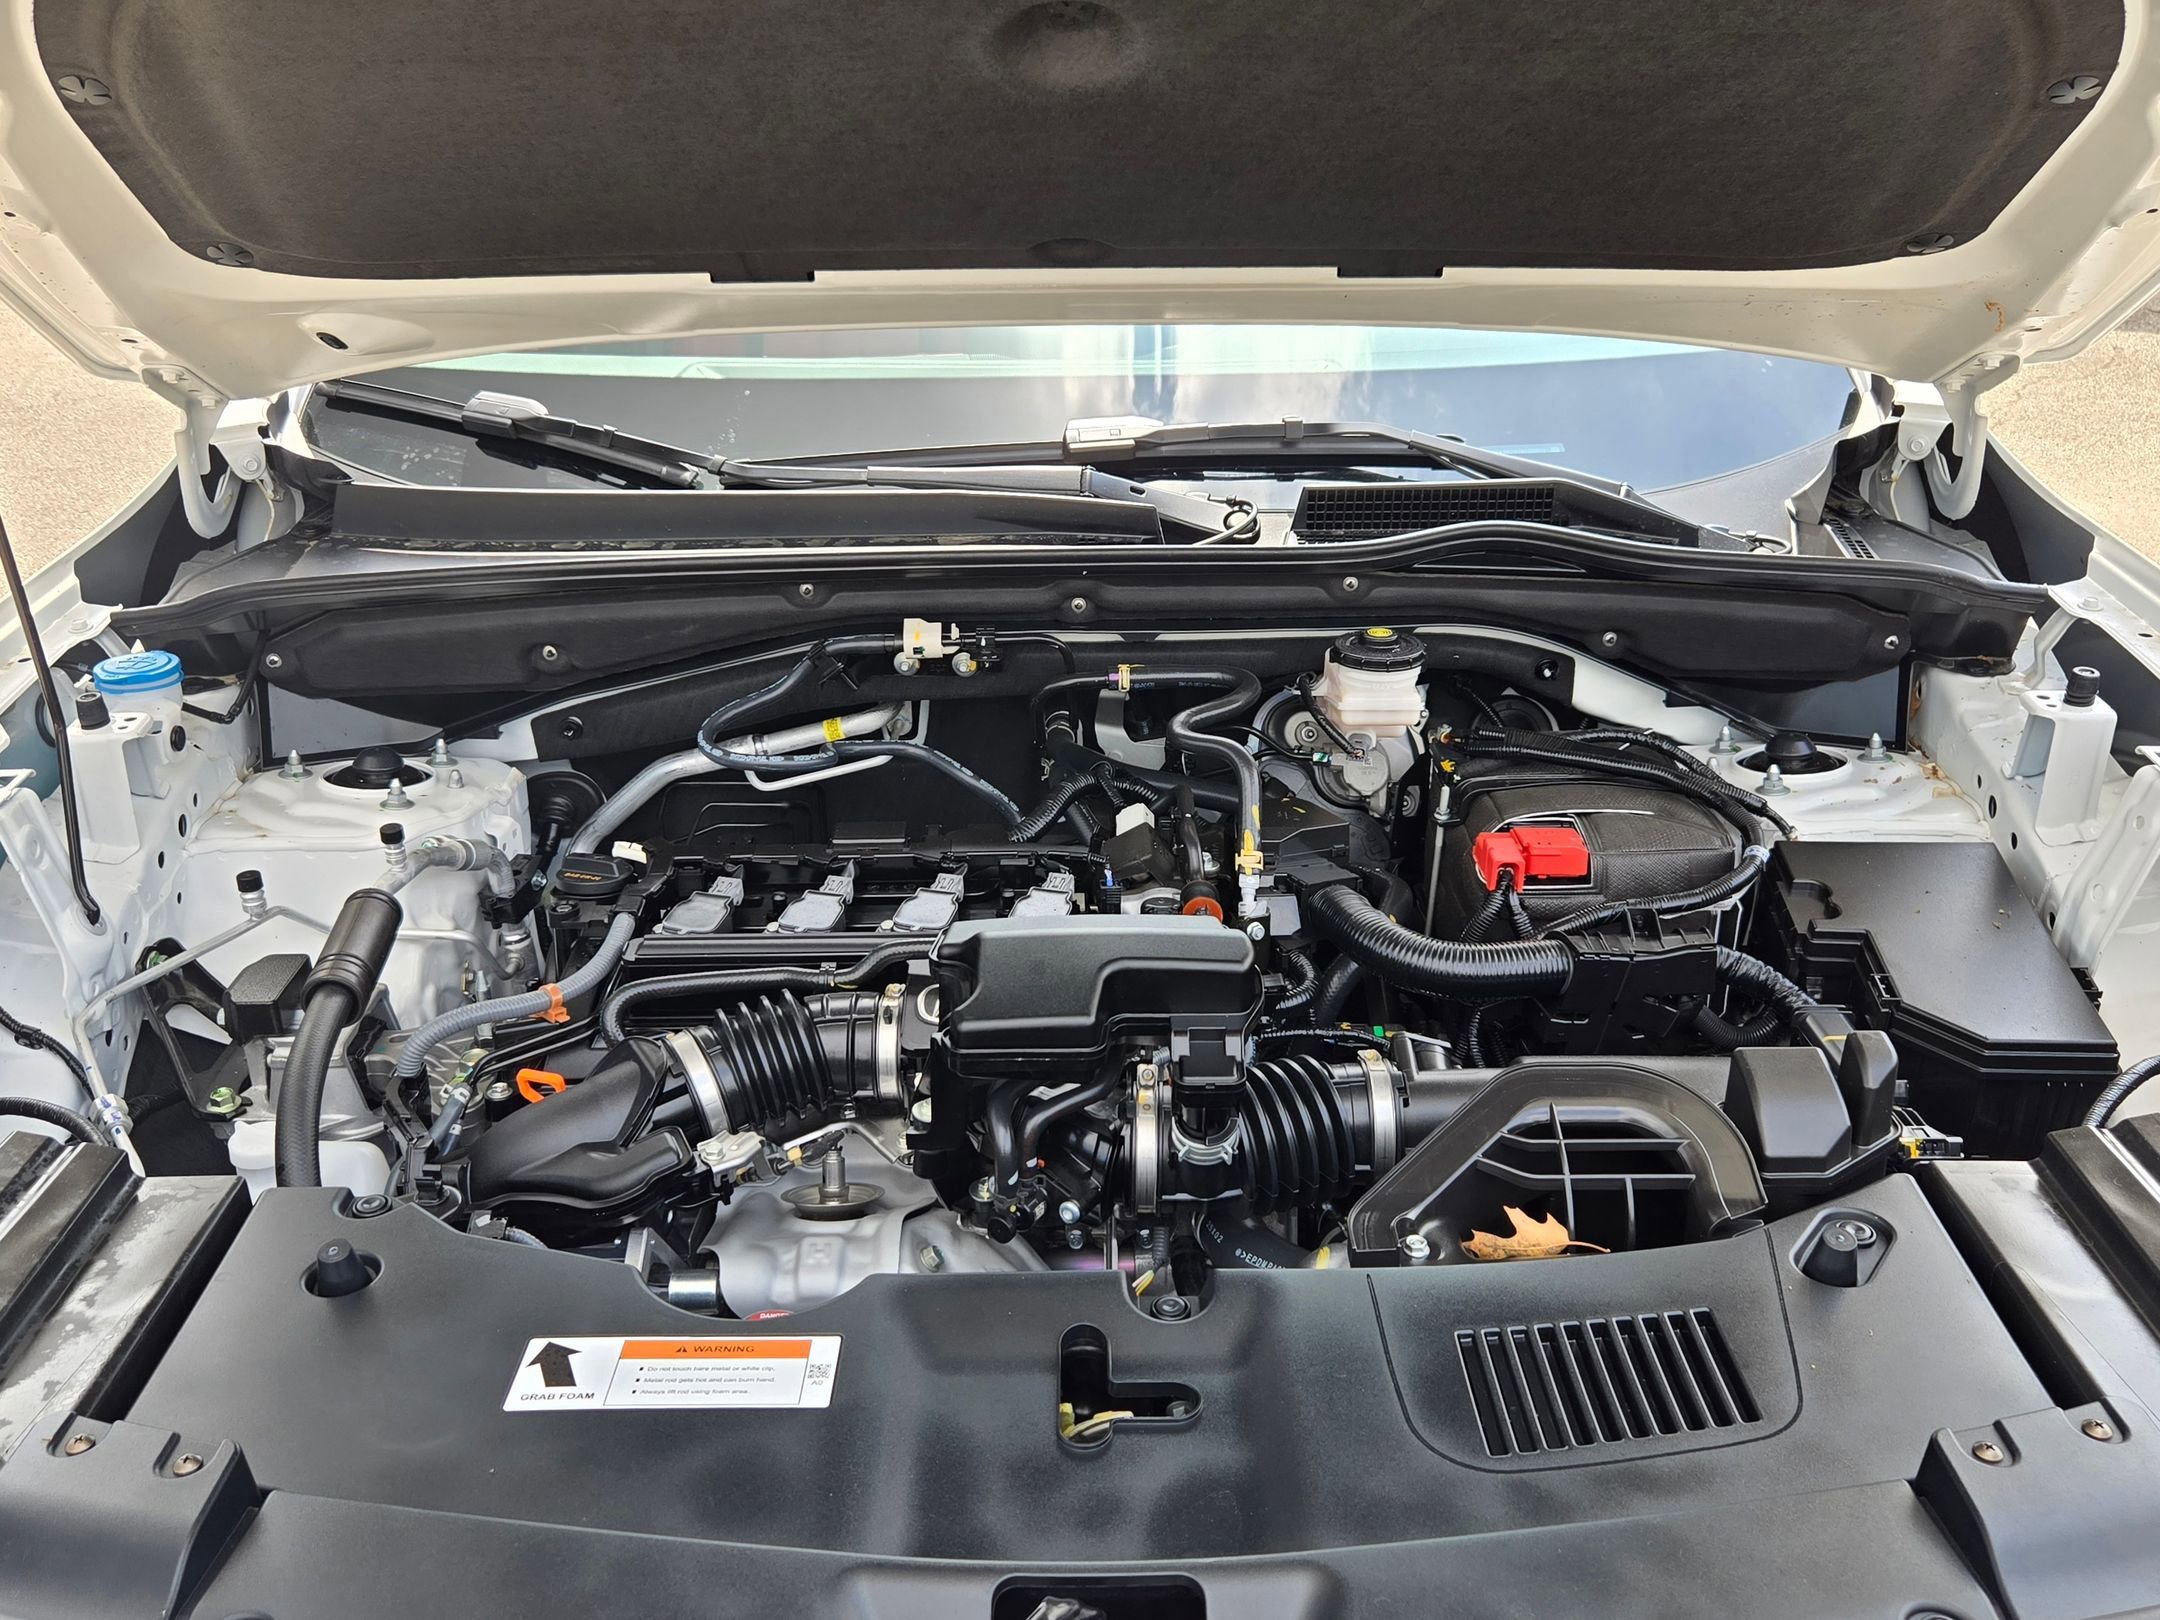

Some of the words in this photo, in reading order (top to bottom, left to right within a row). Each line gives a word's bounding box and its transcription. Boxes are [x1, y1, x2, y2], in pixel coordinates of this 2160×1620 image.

[693, 1345, 755, 1353] WARNING
[520, 1393, 555, 1401] GRAB
[558, 1392, 595, 1400] FOAM
